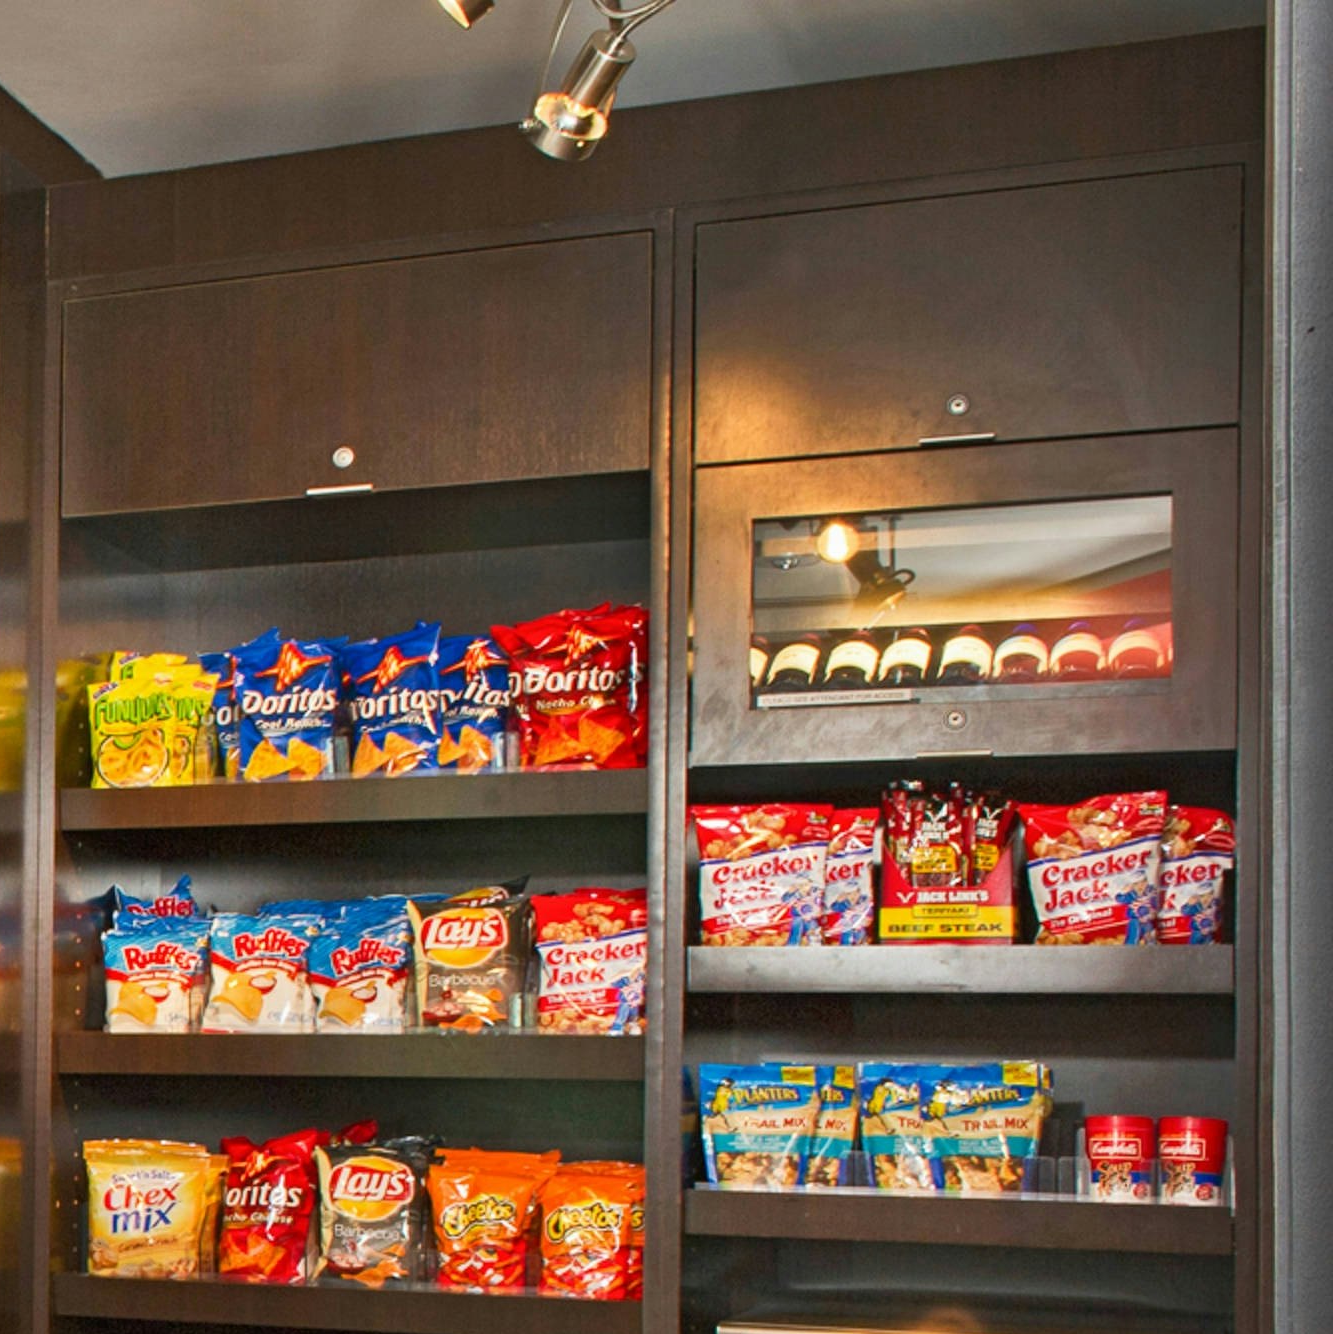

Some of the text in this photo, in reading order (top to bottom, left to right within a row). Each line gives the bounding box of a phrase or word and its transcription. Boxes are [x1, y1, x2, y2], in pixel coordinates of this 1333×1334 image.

[242, 685, 337, 715] Doritos
[713, 854, 818, 885] Cracker
[1042, 849, 1152, 887] Cracker
[1160, 863, 1221, 888] cker
[917, 890, 947, 903] JACK
[1045, 880, 1110, 911] Jack
[233, 927, 310, 958] Ruffles
[424, 914, 501, 950] Lay's
[888, 923, 1003, 933] BEEF STEAK
[123, 941, 200, 973] Ruffles
[331, 938, 406, 976] Ruffles
[546, 940, 647, 966] Cracker
[428, 974, 497, 988] Barbecue
[546, 966, 606, 988] Jack
[733, 1087, 800, 1104] PLANTERS
[898, 1116, 923, 1129] TRA
[1004, 1118, 1031, 1130] MIX
[103, 1182, 181, 1211] Chex
[225, 1179, 304, 1208] oritos
[333, 1166, 408, 1202] Lay's
[111, 1201, 177, 1234] mix
[442, 1200, 515, 1238] Cheetos
[547, 1205, 620, 1242] Cheetos
